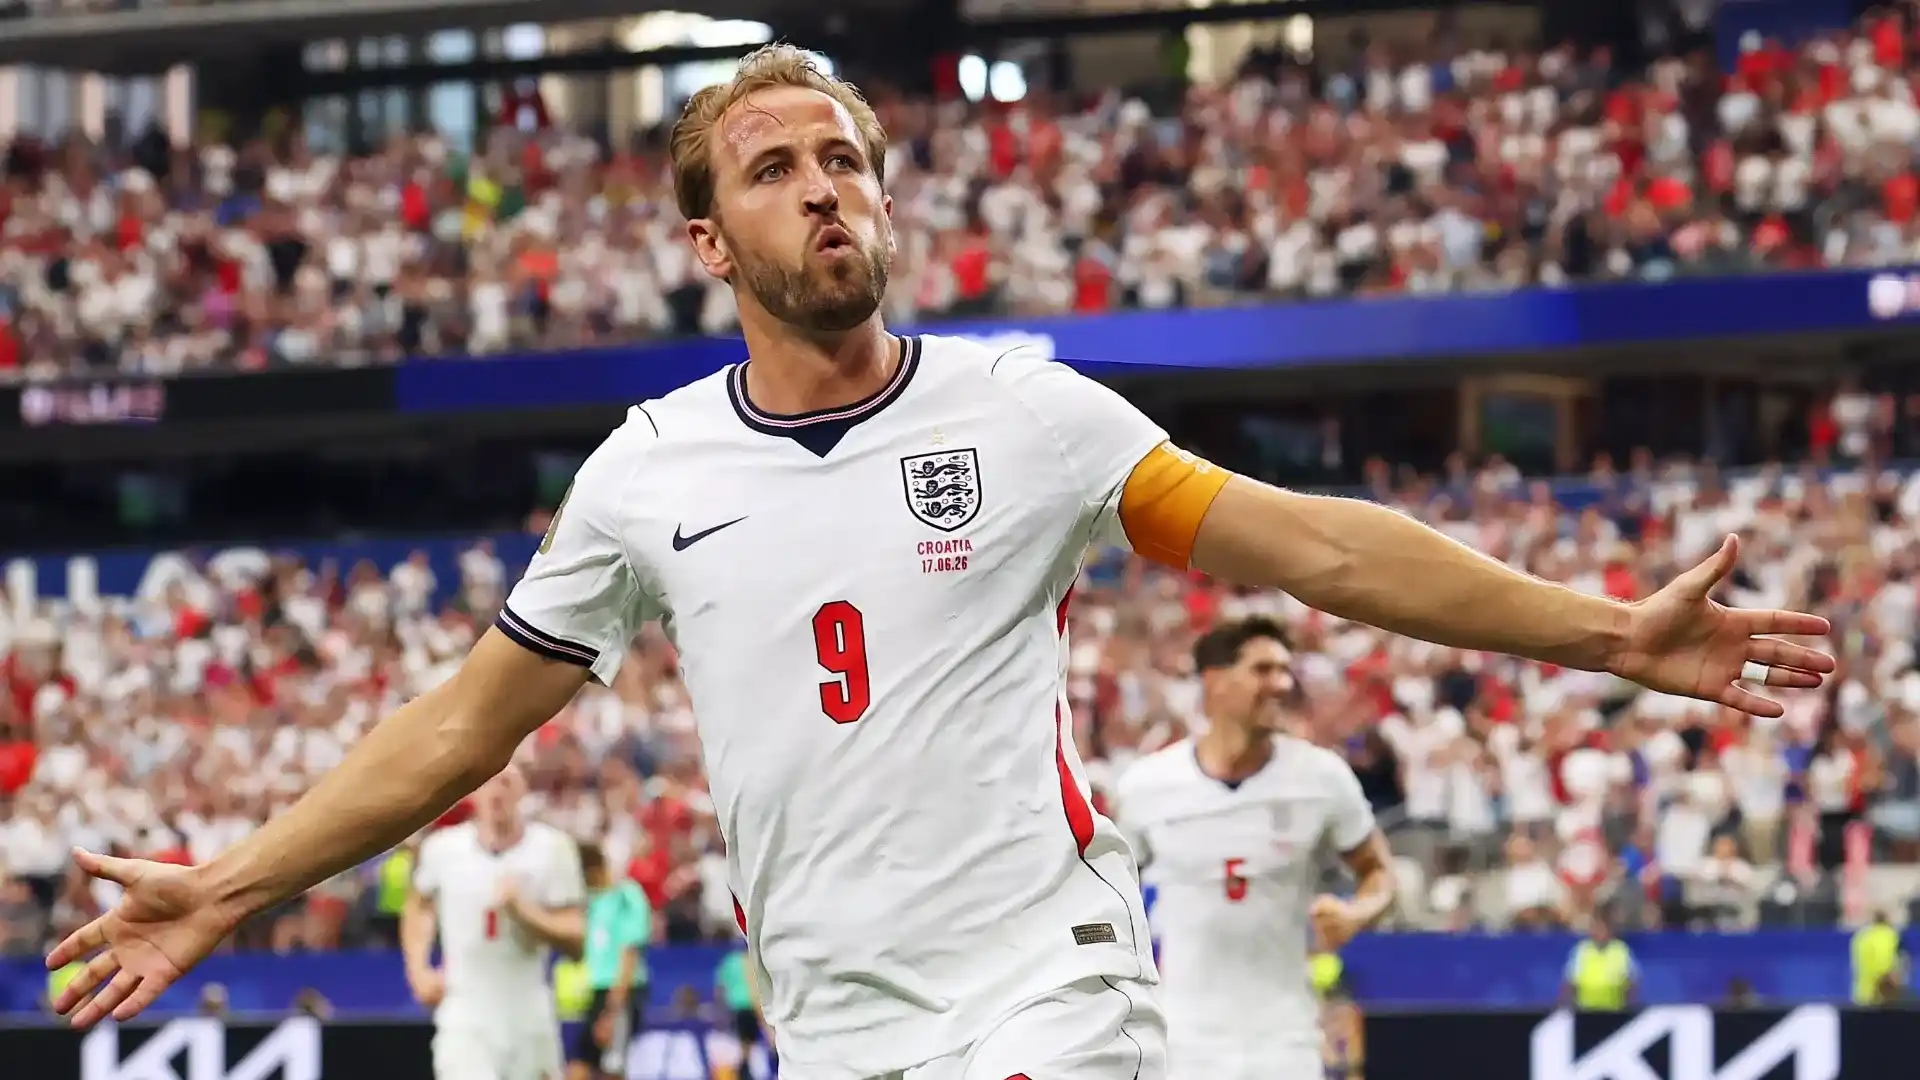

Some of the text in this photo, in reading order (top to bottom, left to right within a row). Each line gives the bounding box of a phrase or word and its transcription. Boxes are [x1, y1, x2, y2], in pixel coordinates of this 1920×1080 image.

[917, 539, 973, 555] CROATIA
[921, 556, 968, 573] 17.06.26
[812, 600, 870, 724] 9
[1223, 857, 1248, 903] 5
